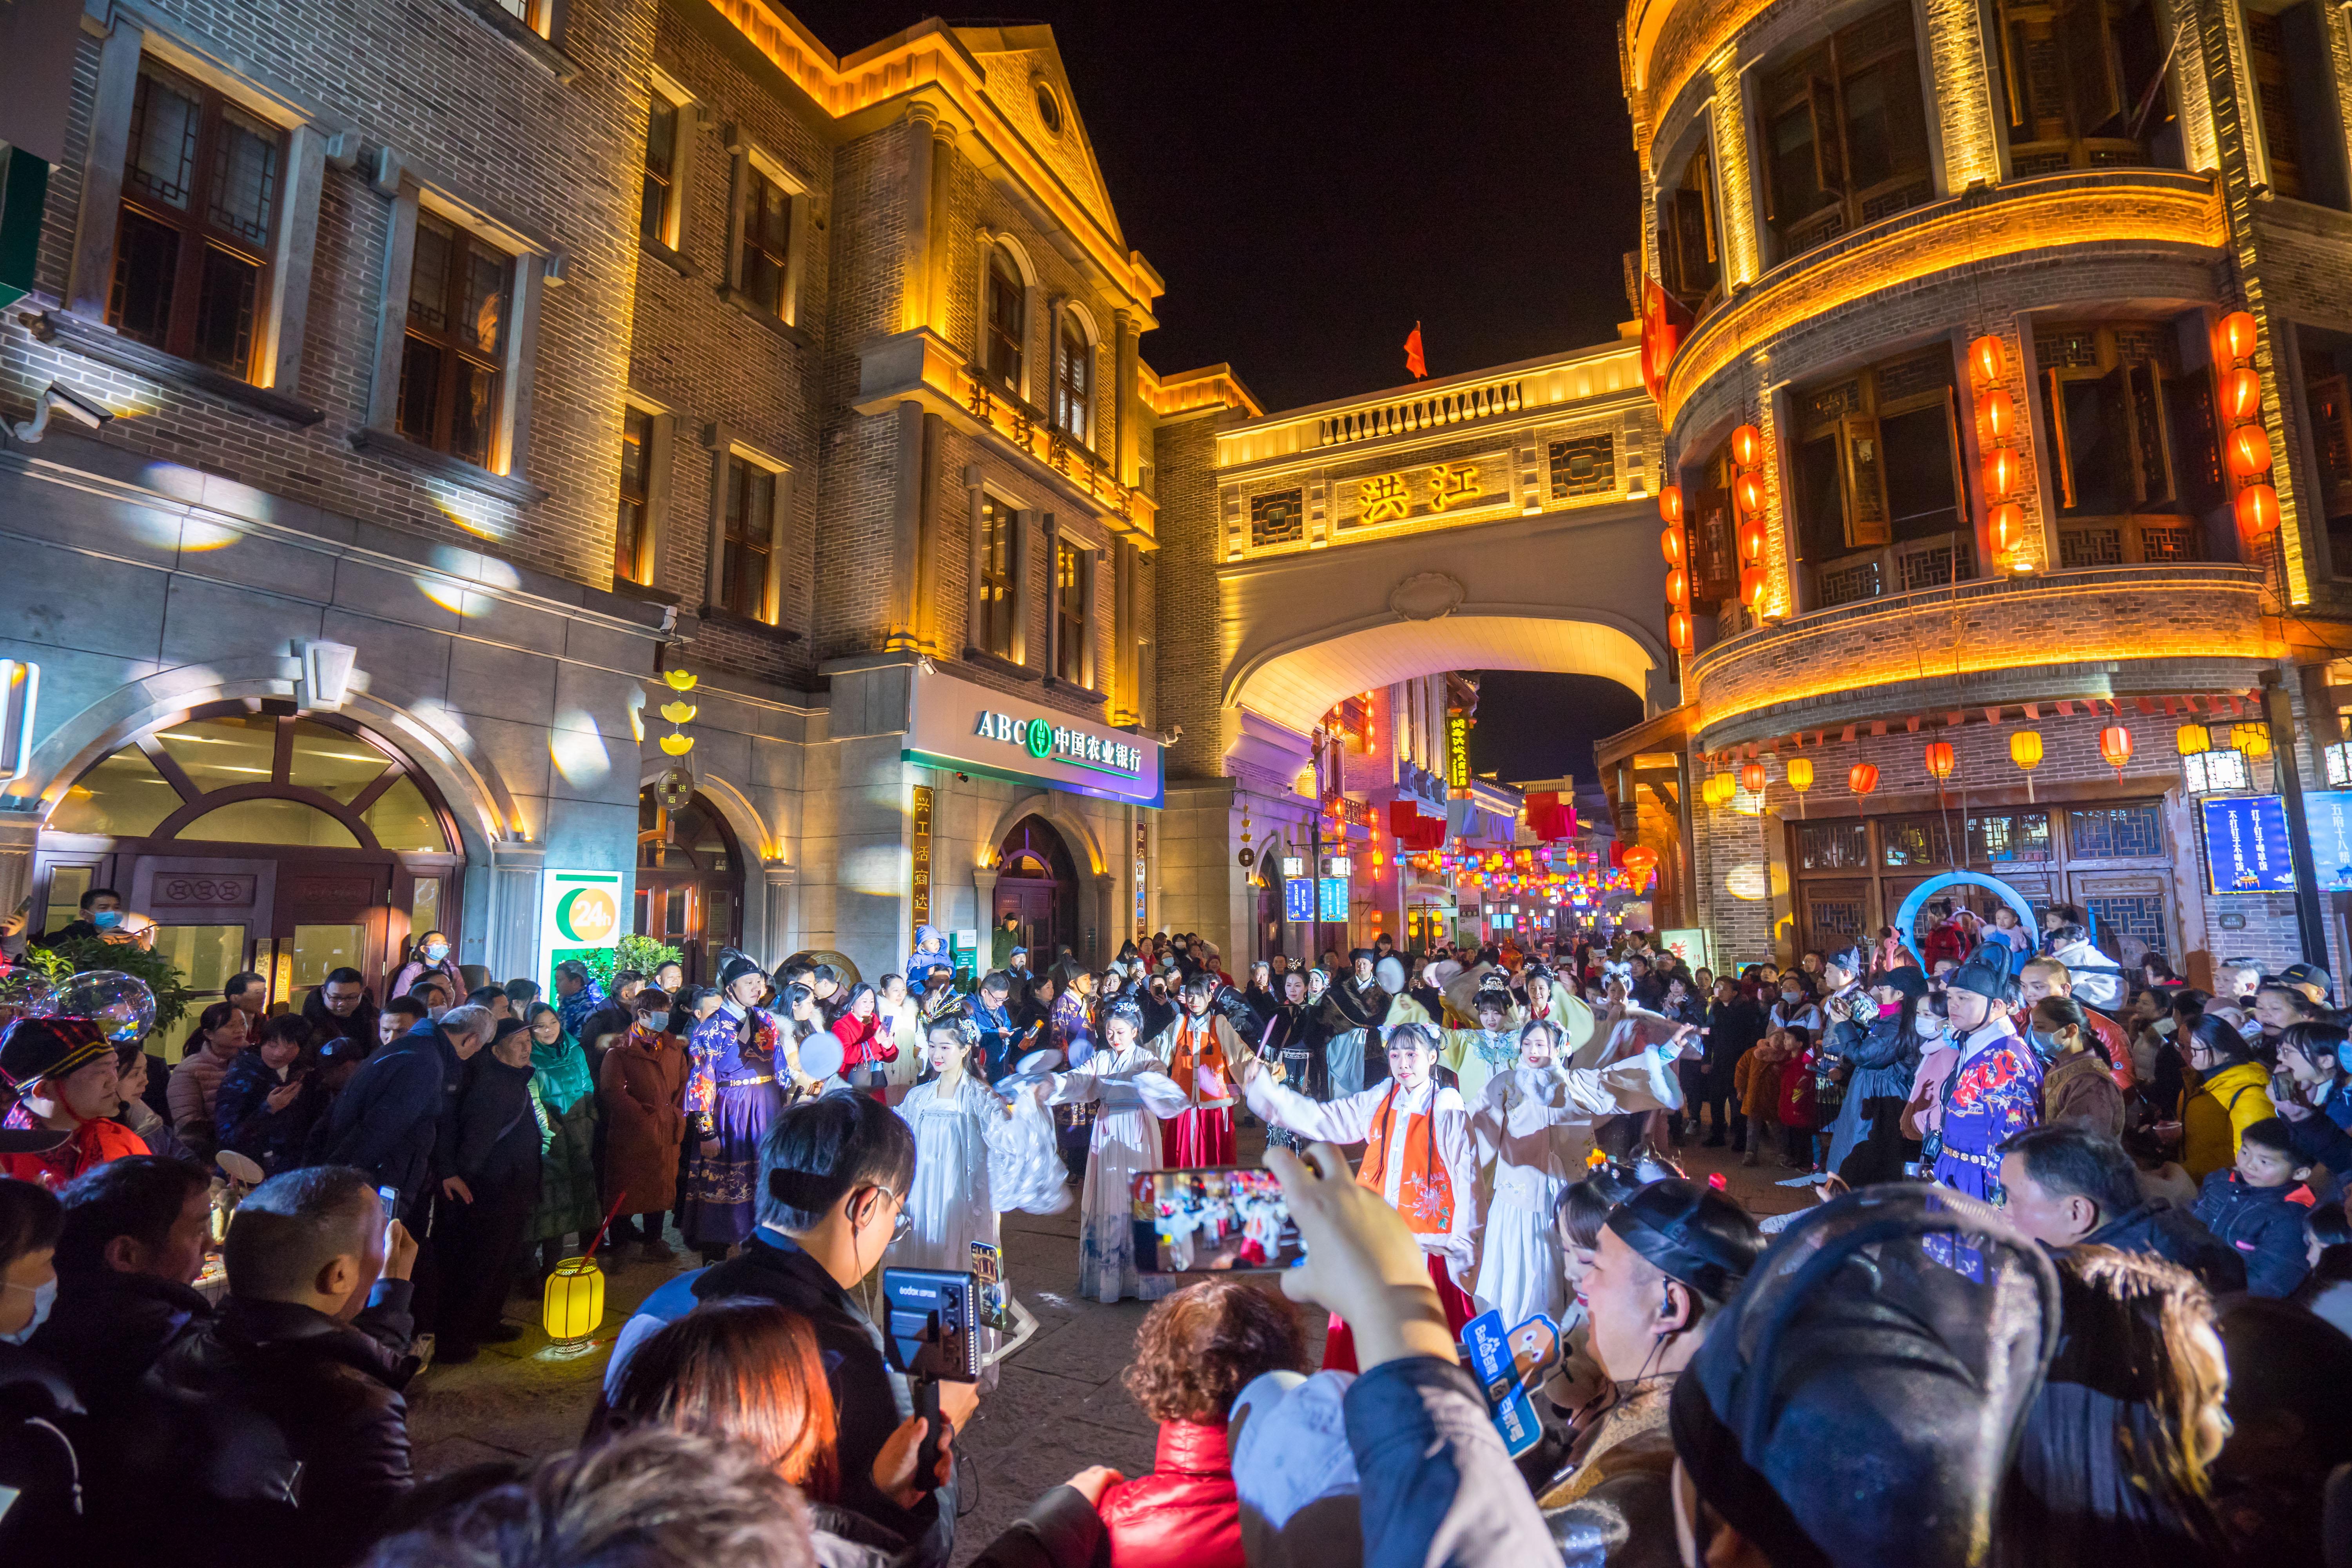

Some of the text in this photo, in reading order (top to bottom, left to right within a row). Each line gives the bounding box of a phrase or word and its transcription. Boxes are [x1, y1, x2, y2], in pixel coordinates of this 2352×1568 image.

[1360, 465, 1481, 523] 洪江
[978, 710, 1027, 745] ABC
[1054, 726, 1141, 772] 中国农业银行
[2330, 804, 2350, 863] 五府十八帮
[915, 797, 930, 946] 兴工活商达三
[574, 900, 612, 927] 24h
[899, 1285, 919, 1296] Godox
[1501, 1396, 1525, 1443] 百家号
